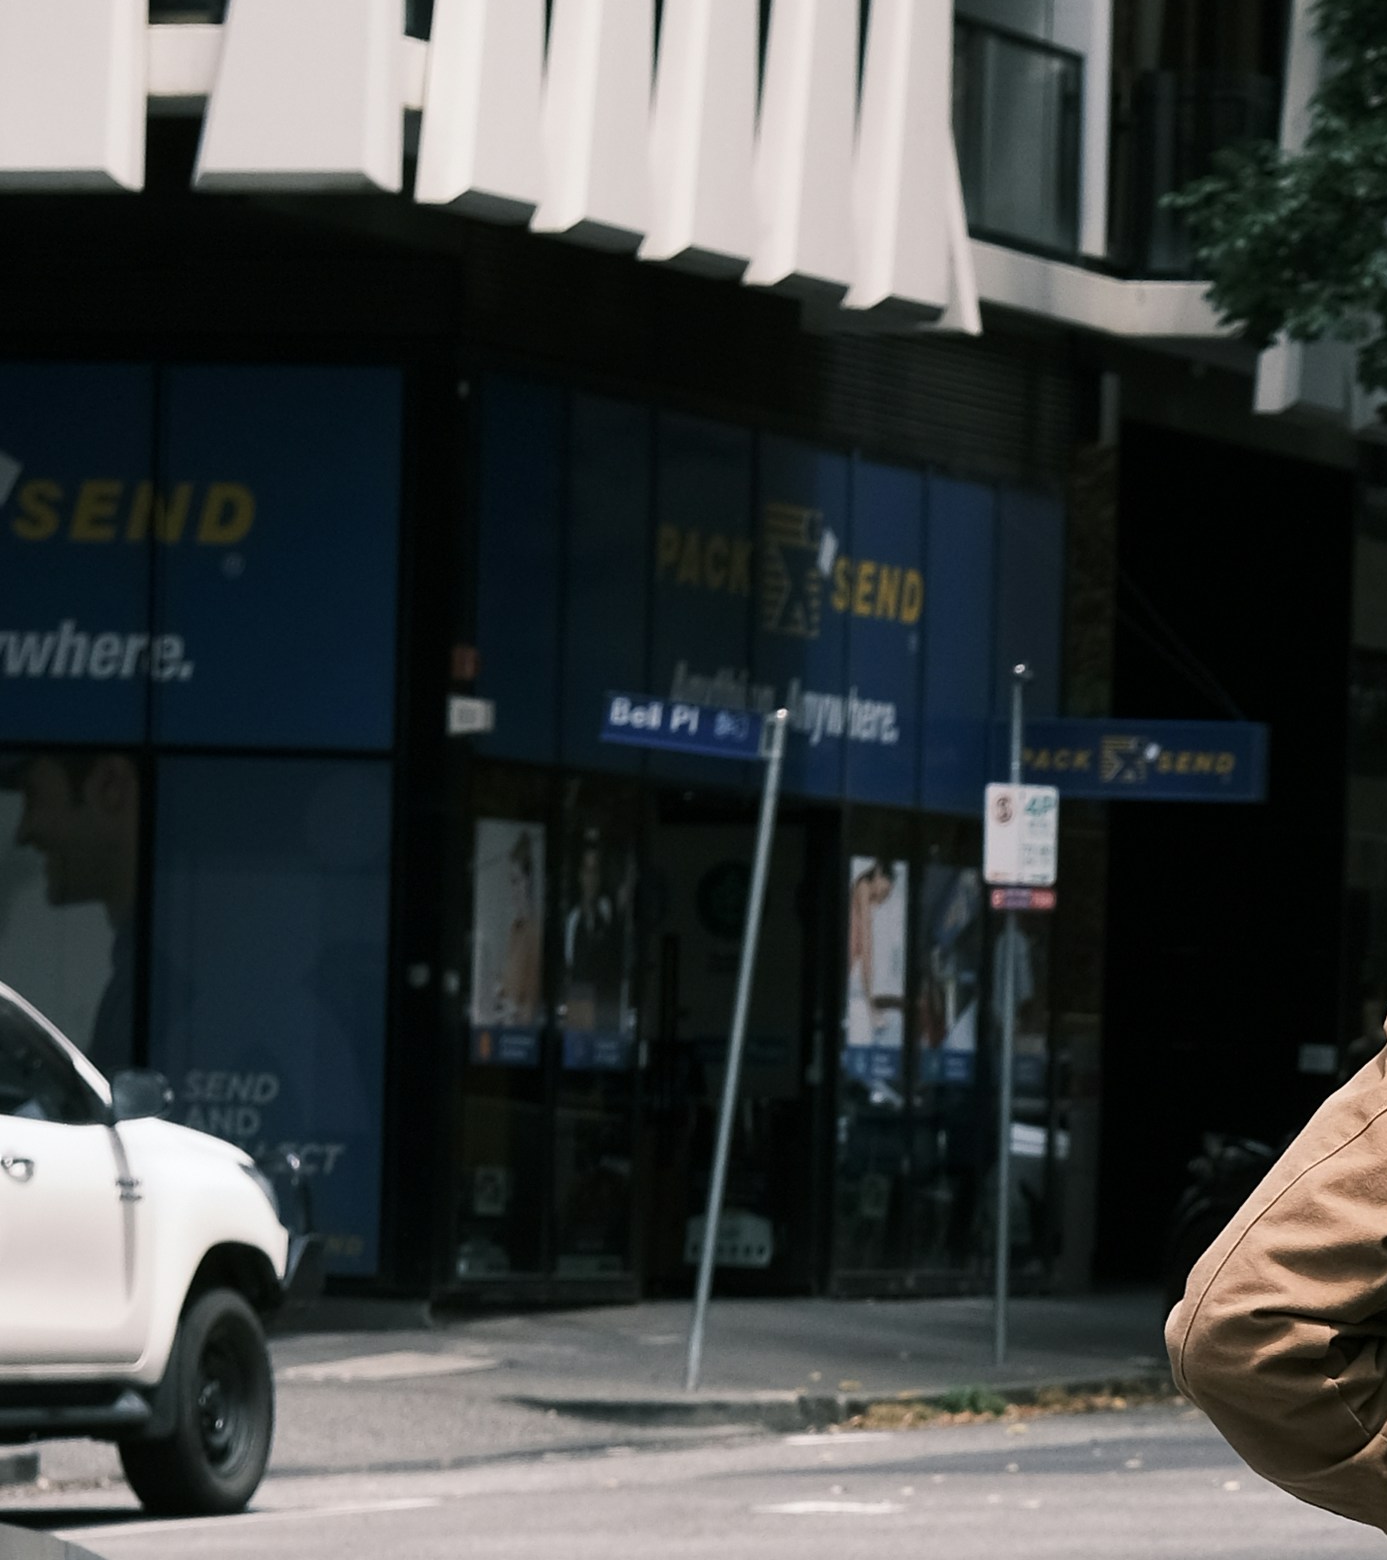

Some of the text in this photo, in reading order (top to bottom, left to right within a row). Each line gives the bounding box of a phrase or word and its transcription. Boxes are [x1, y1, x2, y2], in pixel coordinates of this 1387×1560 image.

[11, 478, 257, 545] SEND
[657, 521, 925, 626] PACK SEND
[610, 697, 663, 730] Bell
[1156, 750, 1236, 776] SEND
[183, 1069, 280, 1104] SEND
